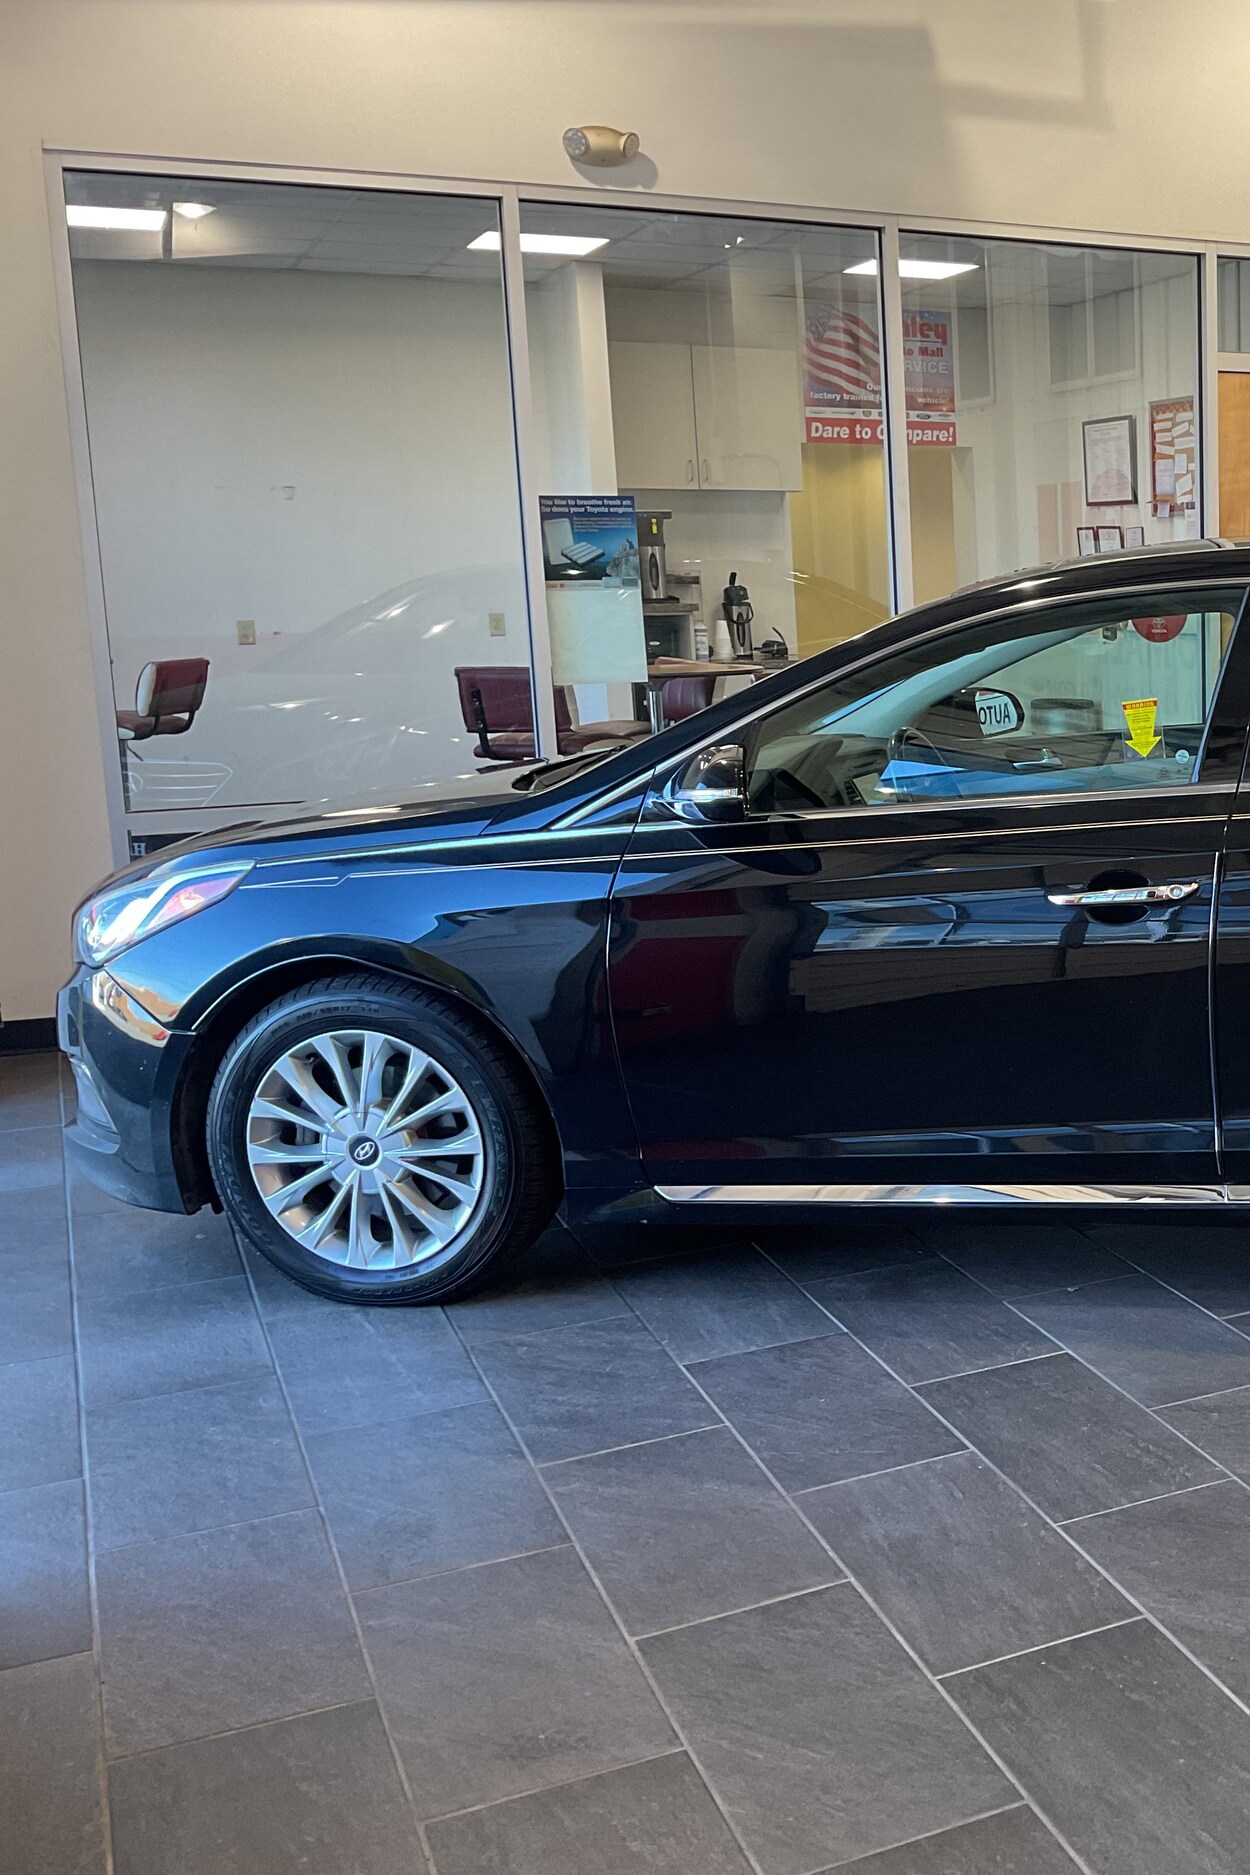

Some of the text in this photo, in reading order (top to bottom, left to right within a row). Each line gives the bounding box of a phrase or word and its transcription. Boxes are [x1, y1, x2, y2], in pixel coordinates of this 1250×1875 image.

[903, 315, 948, 346] ley
[905, 359, 948, 374] RVICE
[810, 391, 841, 402] factory
[843, 392, 875, 401] trained
[811, 421, 954, 445] Dare to Cpare!
[586, 505, 609, 514] Toyota
